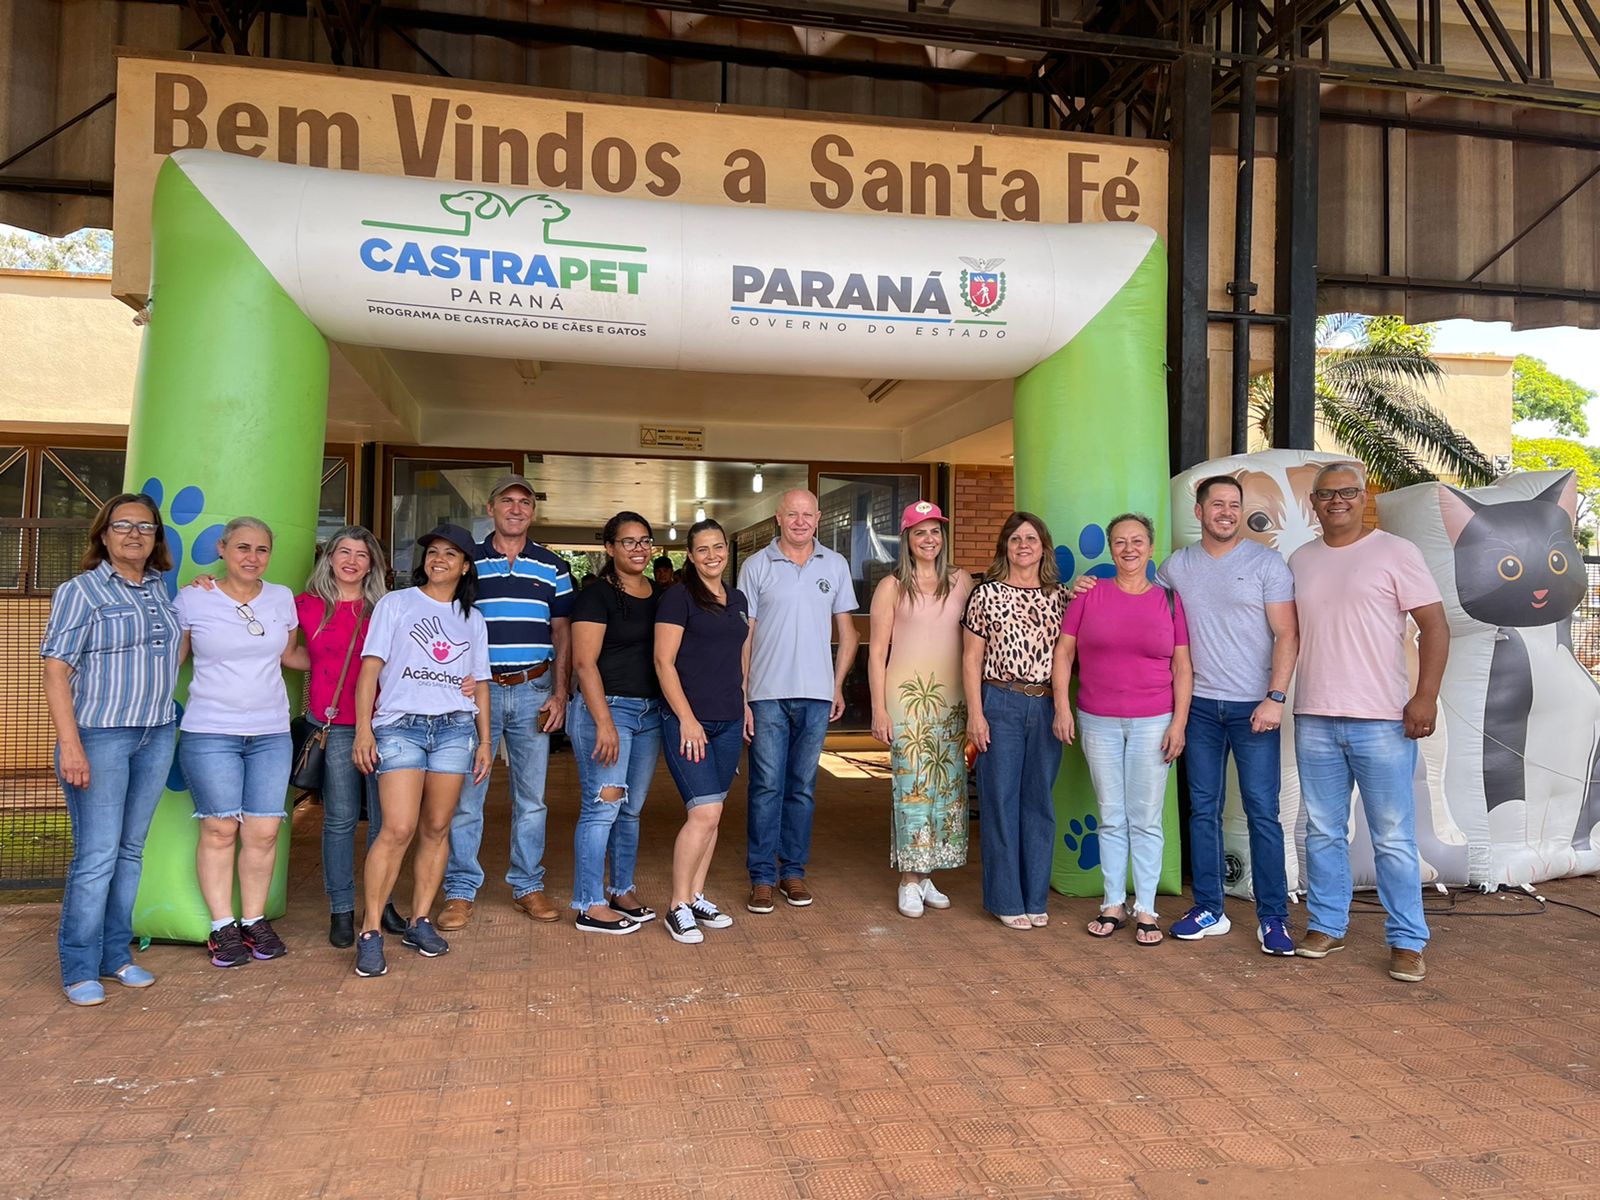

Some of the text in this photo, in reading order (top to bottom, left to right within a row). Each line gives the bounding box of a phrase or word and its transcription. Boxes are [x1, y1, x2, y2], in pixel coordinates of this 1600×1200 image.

[154, 72, 1140, 223] Bem Vindos a Santa Fé
[360, 237, 648, 295] CASTRAPET
[450, 287, 564, 311] PARANÁ
[732, 264, 952, 315] PARANÁ
[368, 305, 647, 337] PROGRAMA DE CASTRAÇÃO DE CÃES E GATOS
[731, 315, 1006, 339] GOVERNO DO ESTADO
